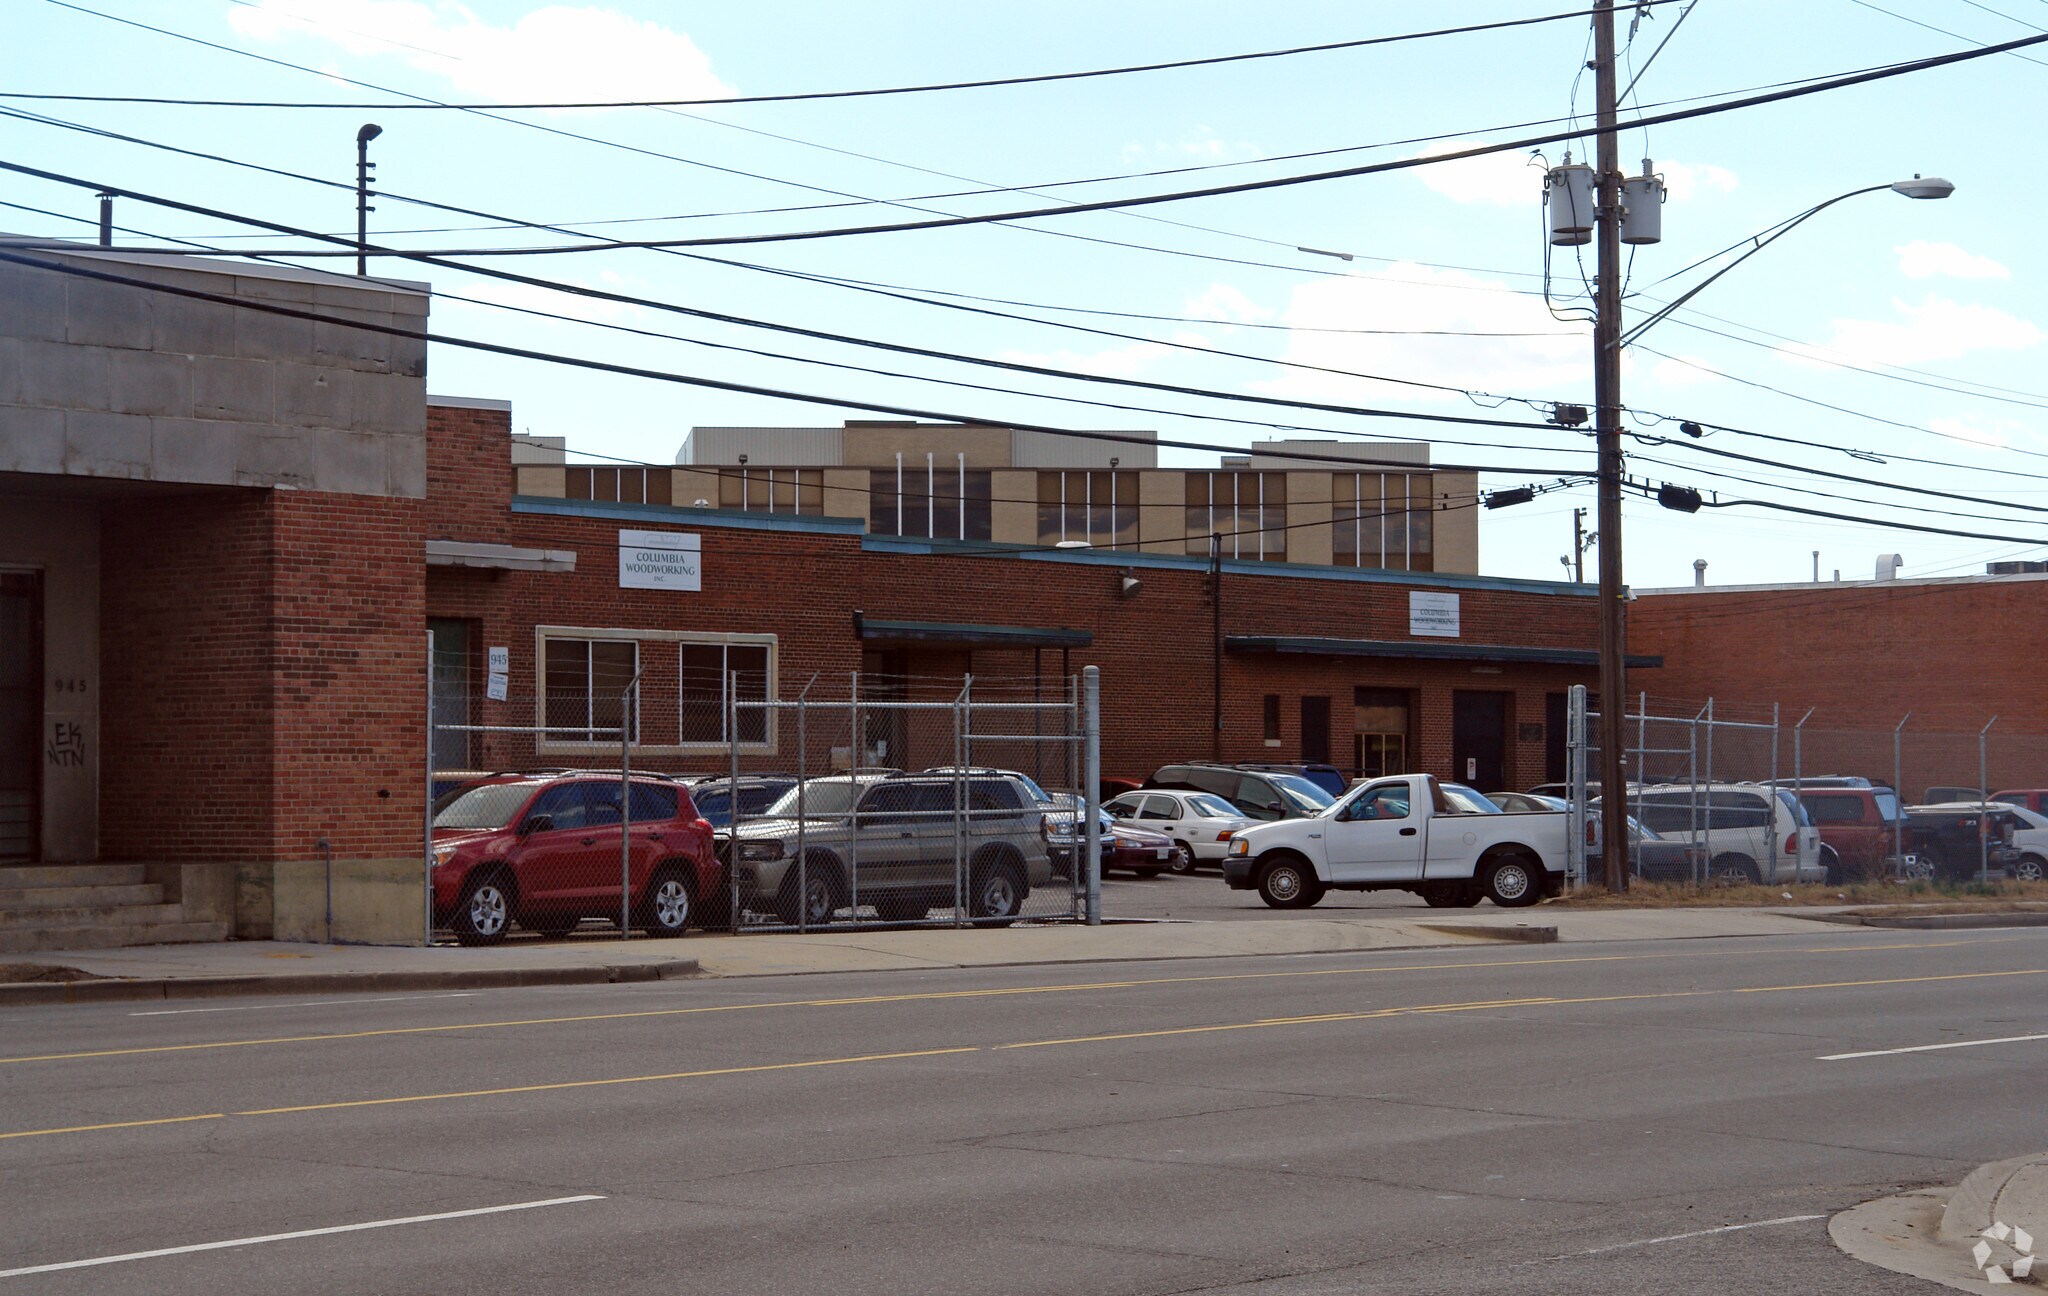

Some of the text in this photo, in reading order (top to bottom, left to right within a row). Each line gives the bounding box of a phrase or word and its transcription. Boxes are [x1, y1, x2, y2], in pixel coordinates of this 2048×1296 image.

[636, 552, 685, 564] COLUMBIA
[626, 563, 695, 576] WOODWORKING
[490, 654, 507, 665] 945
[55, 680, 87, 692] 945
